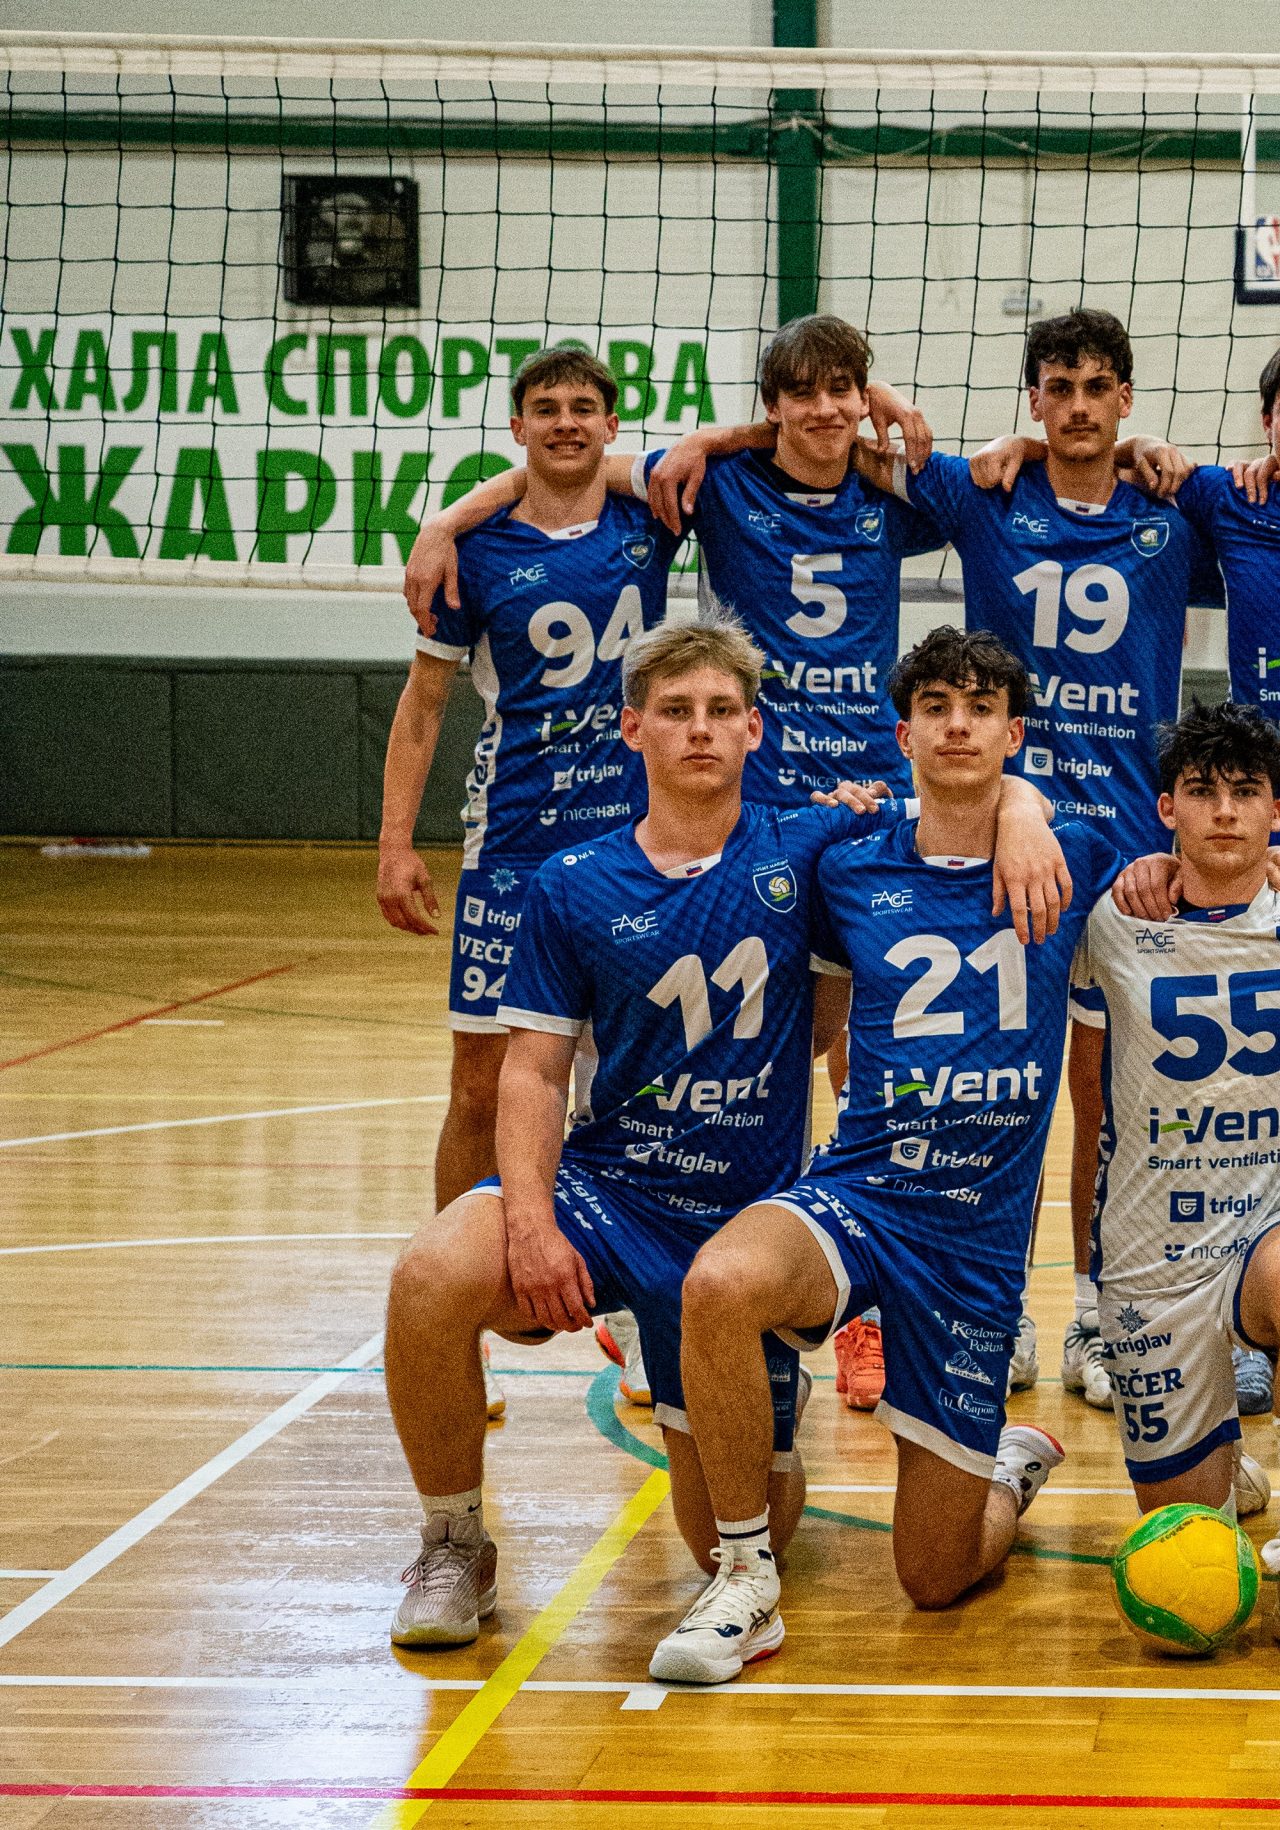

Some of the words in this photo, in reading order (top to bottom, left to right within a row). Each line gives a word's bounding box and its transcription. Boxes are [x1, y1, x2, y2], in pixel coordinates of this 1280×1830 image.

[8, 327, 240, 414] ХАЛА
[264, 331, 717, 423] СПОРТВА
[0, 443, 515, 565] ЖАРК
[786, 553, 848, 638] 5
[1012, 560, 1130, 654] 19
[527, 584, 645, 688] 94
[1055, 721, 1136, 740] ventilation
[809, 735, 868, 757] triglav
[576, 763, 624, 784] triglav
[1056, 757, 1113, 780] triglav
[872, 889, 914, 909] FACE
[487, 908, 522, 932] trigl
[611, 909, 659, 936] FACE
[1135, 927, 1176, 945] FACE
[646, 936, 770, 1052] 11
[883, 928, 1028, 1039] 21
[619, 1115, 675, 1140] Smart
[657, 1145, 732, 1175] triglav
[1147, 1155, 1202, 1171] Smart
[1116, 1331, 1172, 1357] triglav
[1123, 1401, 1169, 1443] 55
